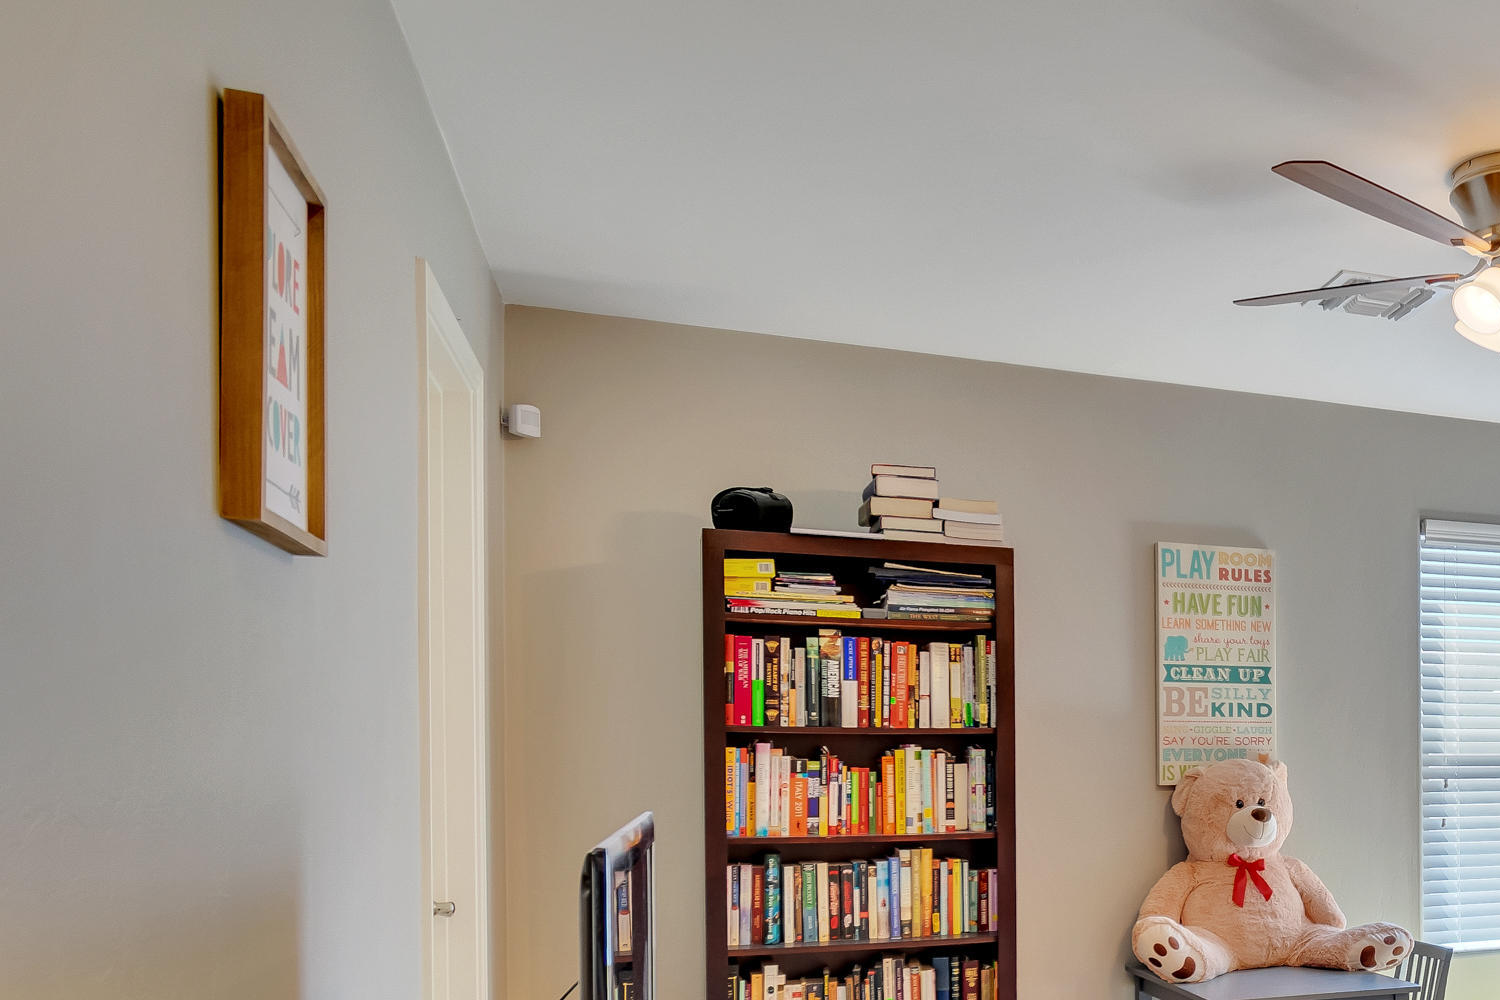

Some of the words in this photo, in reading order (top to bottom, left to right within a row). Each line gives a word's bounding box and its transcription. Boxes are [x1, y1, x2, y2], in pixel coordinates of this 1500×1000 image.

[1161, 548, 1216, 580] PLAY
[1218, 551, 1272, 567] ROOM
[1218, 568, 1272, 583] RULES
[1172, 591, 1222, 616] HAVE
[1227, 594, 1262, 617] FUN
[1161, 616, 1191, 630] LEARN
[1195, 618, 1247, 632] SOMETHING
[1250, 620, 1272, 633] NEW
[1192, 633, 1221, 644] share
[1224, 636, 1246, 648] your
[1250, 635, 1270, 648] toys
[1196, 647, 1231, 662] PLAY
[1238, 648, 1270, 663] FAIR
[827, 660, 840, 698] AMERICAN
[1170, 666, 1232, 682] CLEAN
[1239, 668, 1265, 683] UP
[1163, 686, 1209, 718] BE
[1211, 688, 1272, 701] SILLY
[1211, 702, 1273, 718] KIND
[1163, 736, 1185, 745] SAY
[1190, 736, 1230, 746] YOU'RE
[1235, 736, 1272, 746] SORRY
[1162, 765, 1175, 781] IS
[795, 782, 803, 799] ITALY
[795, 802, 803, 817] 2011
